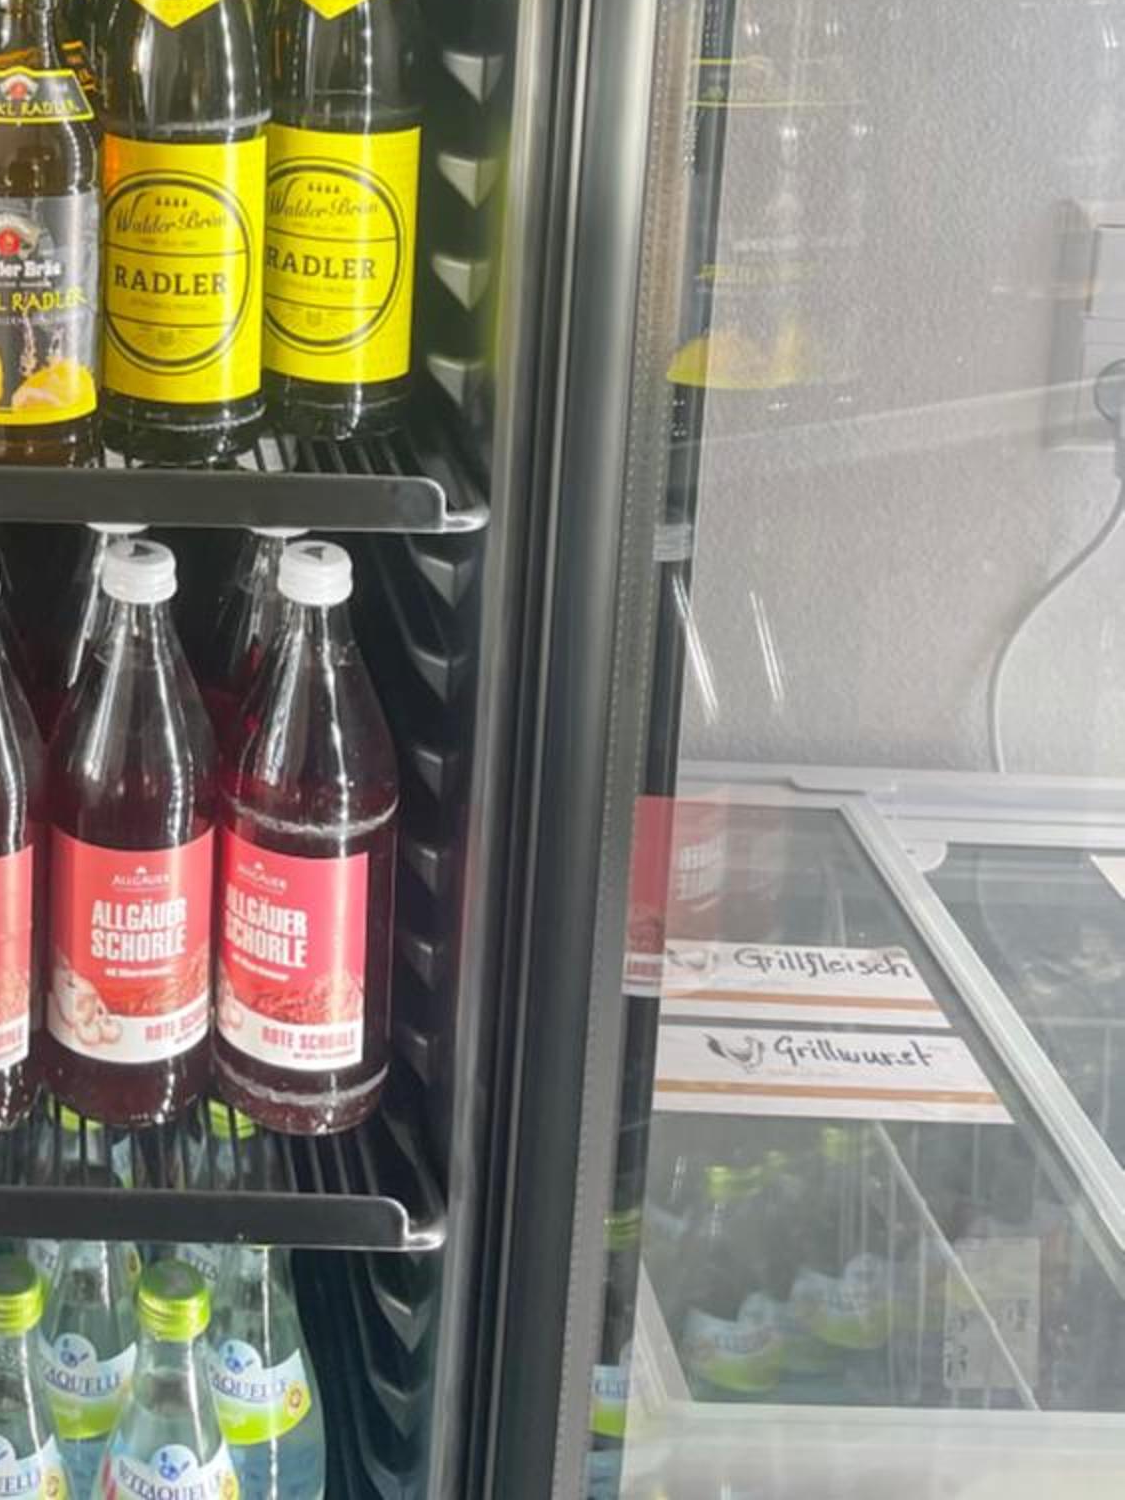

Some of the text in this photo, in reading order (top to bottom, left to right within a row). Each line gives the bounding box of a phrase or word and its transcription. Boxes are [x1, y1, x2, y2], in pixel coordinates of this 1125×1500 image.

[266, 247, 378, 281] RADLER
[114, 265, 228, 297] RADLER
[91, 898, 187, 931] ALLGÄUER
[90, 924, 187, 962] SCHORLE
[732, 946, 913, 979] Grillfleisch
[773, 1035, 933, 1068] Grillwurst
